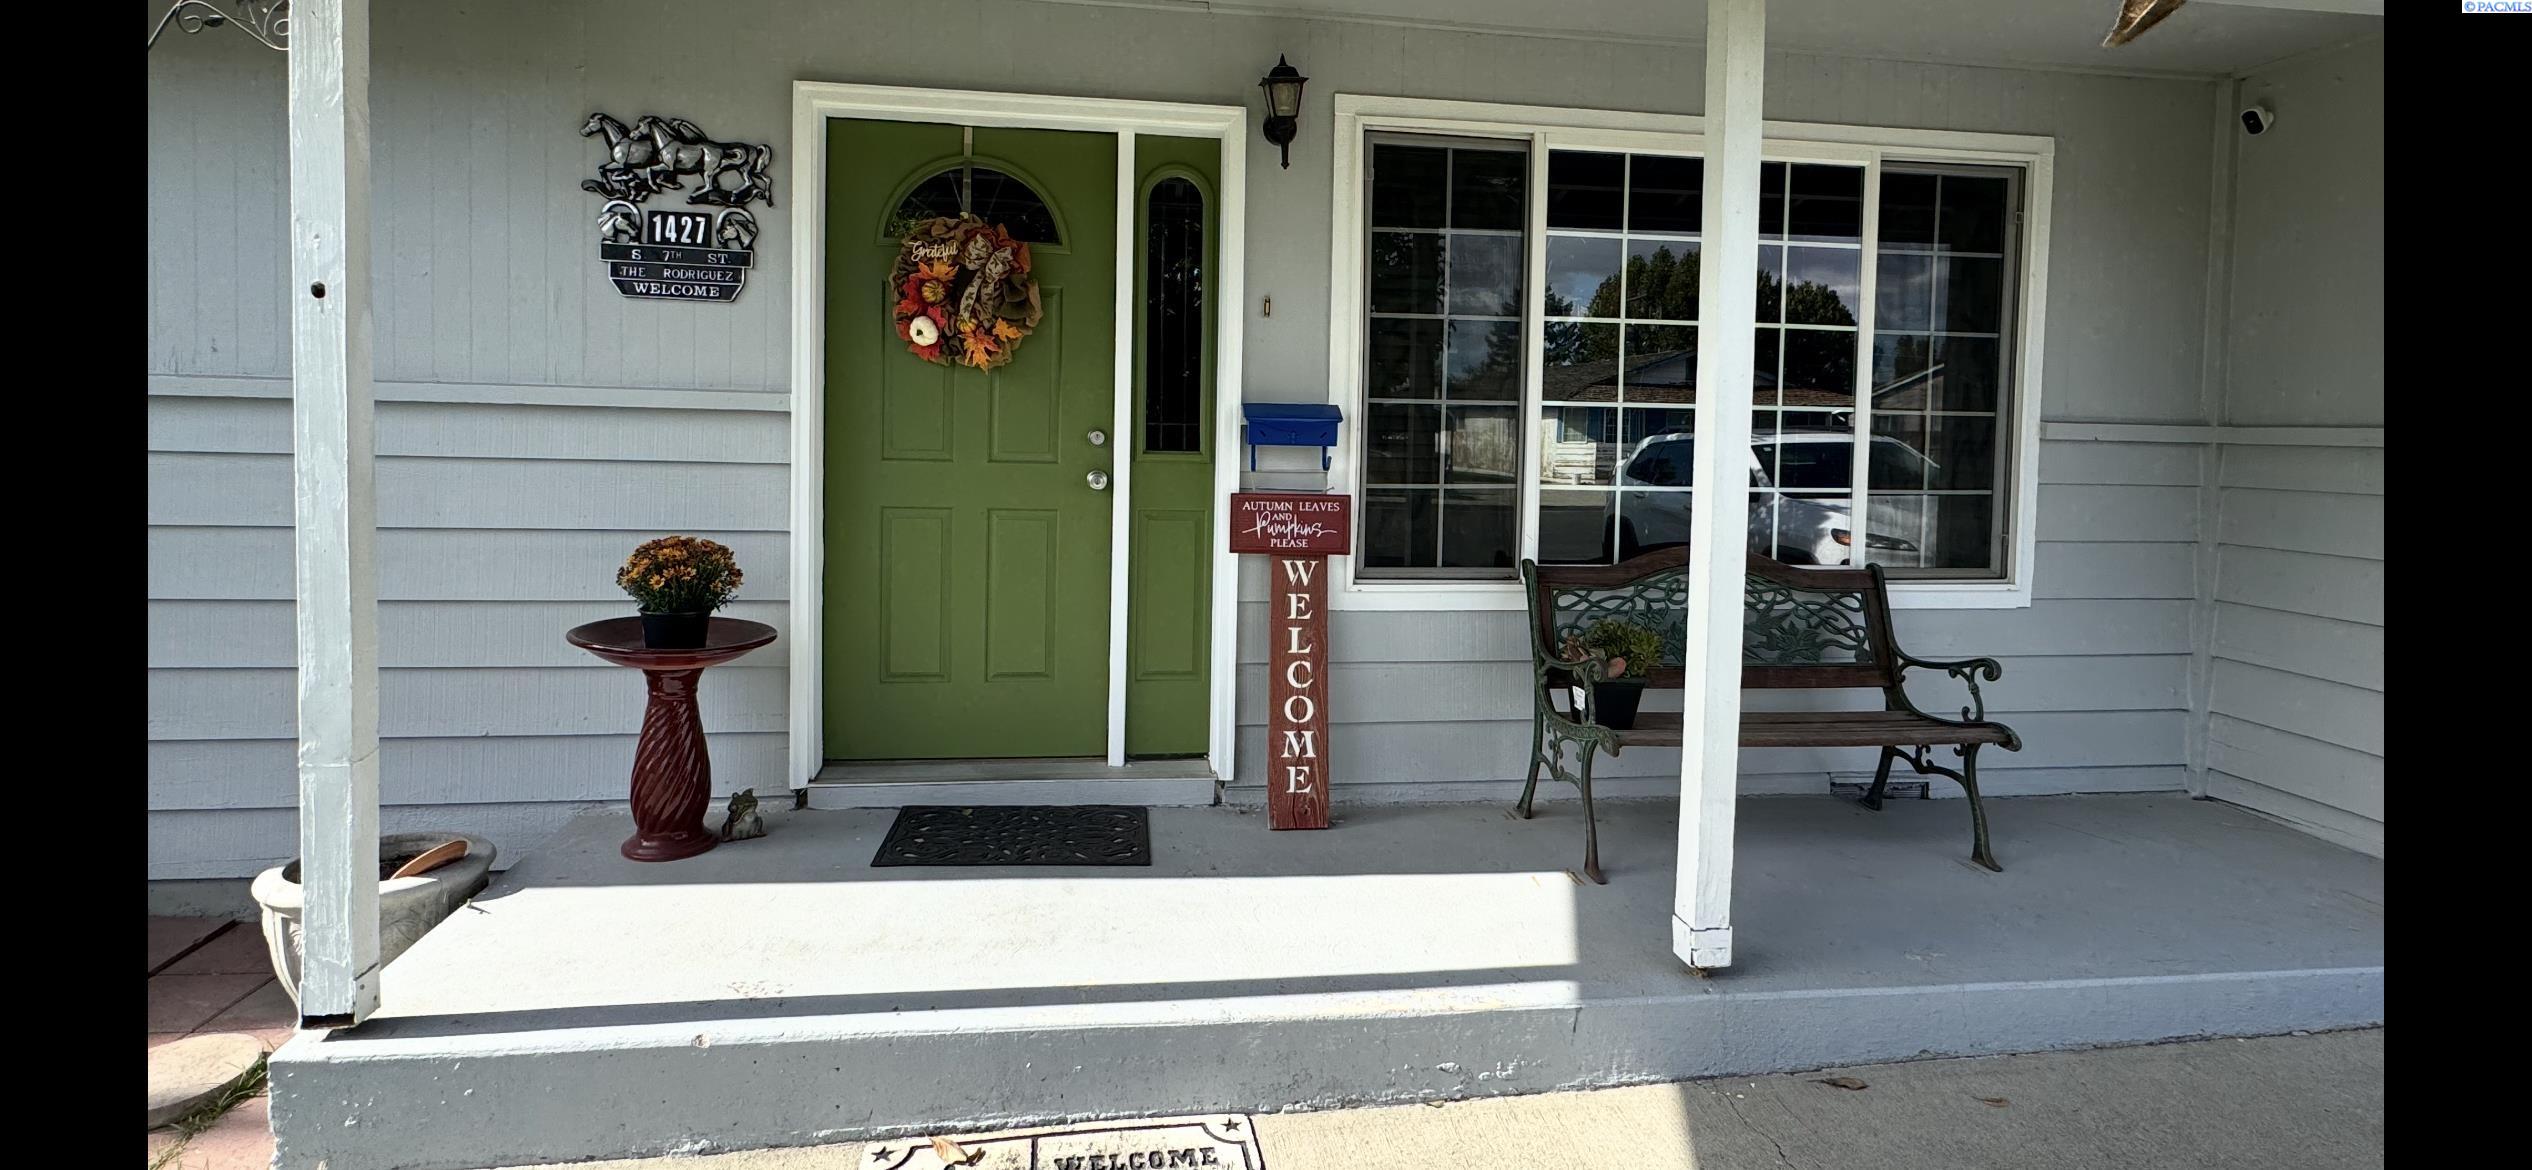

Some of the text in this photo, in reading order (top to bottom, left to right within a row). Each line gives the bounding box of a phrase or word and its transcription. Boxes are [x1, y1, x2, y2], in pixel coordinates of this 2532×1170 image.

[653, 214, 706, 244] 1427
[663, 251, 682, 262] 7TH
[908, 240, 959, 262] Grateful
[621, 265, 734, 281] THE RODRIGUEZ
[633, 282, 720, 297] WELCOME
[1243, 501, 1340, 512] AUTUMN LEAVES
[1272, 512, 1292, 521] AND
[1242, 511, 1338, 540] Pumpkins
[1270, 538, 1309, 548] PLEASE
[1281, 559, 1320, 794] WELCOME
[1054, 1147, 1218, 1170] WELCOME
